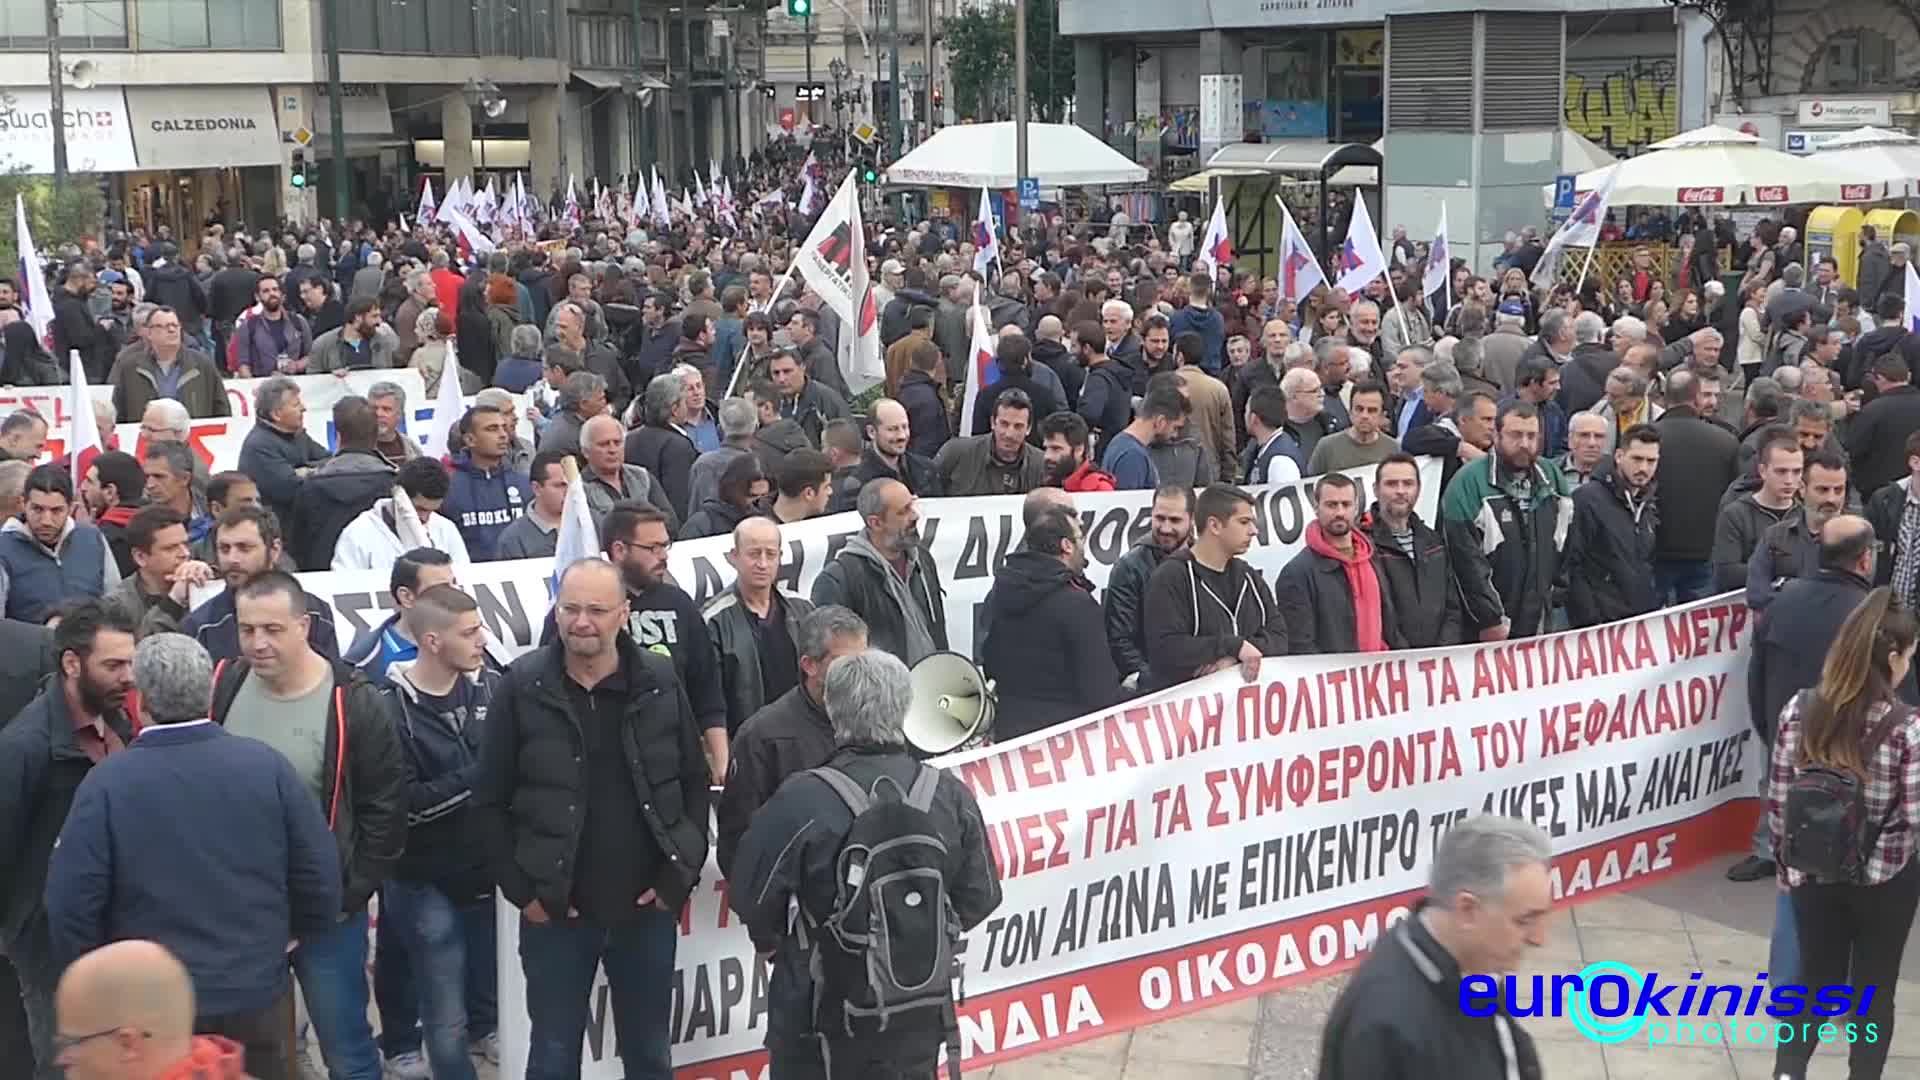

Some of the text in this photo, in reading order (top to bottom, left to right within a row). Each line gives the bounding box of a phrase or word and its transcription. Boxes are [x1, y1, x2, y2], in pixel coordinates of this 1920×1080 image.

[0, 107, 93, 130] swach
[151, 118, 256, 132] CALZEDONIA
[622, 610, 678, 645] UST
[1236, 659, 1409, 742] ΠΟΛΙΤΙΚΗ
[1418, 656, 1461, 707] ΤΑ
[1472, 620, 1658, 698] ΑΝΤΙΛΑΙΚΑ
[1664, 602, 1749, 664] ΜΕΤΡ
[1083, 798, 1137, 860] ΓΙΑ
[1152, 783, 1192, 839] ΤΑ
[1204, 726, 1462, 828] ΣΥΜΦΕΡΟΝΤΑ
[1471, 717, 1527, 772] ΤΟΥ
[1539, 673, 1728, 758] ΚΕΦΑΛΑΙΟΥ
[982, 907, 1047, 973] ΤΟΝ
[1051, 862, 1176, 956] ΑΓΩΝΑ
[1188, 861, 1230, 924] ΜΕ
[1239, 808, 1420, 911] ΕΠΙΚΕΝΤΡΟ
[1576, 762, 1637, 832] ΜΑΣ
[1637, 729, 1752, 815] ΑΝΑΓΚΕΣ
[944, 984, 1104, 1064] ΝΔΙΑ
